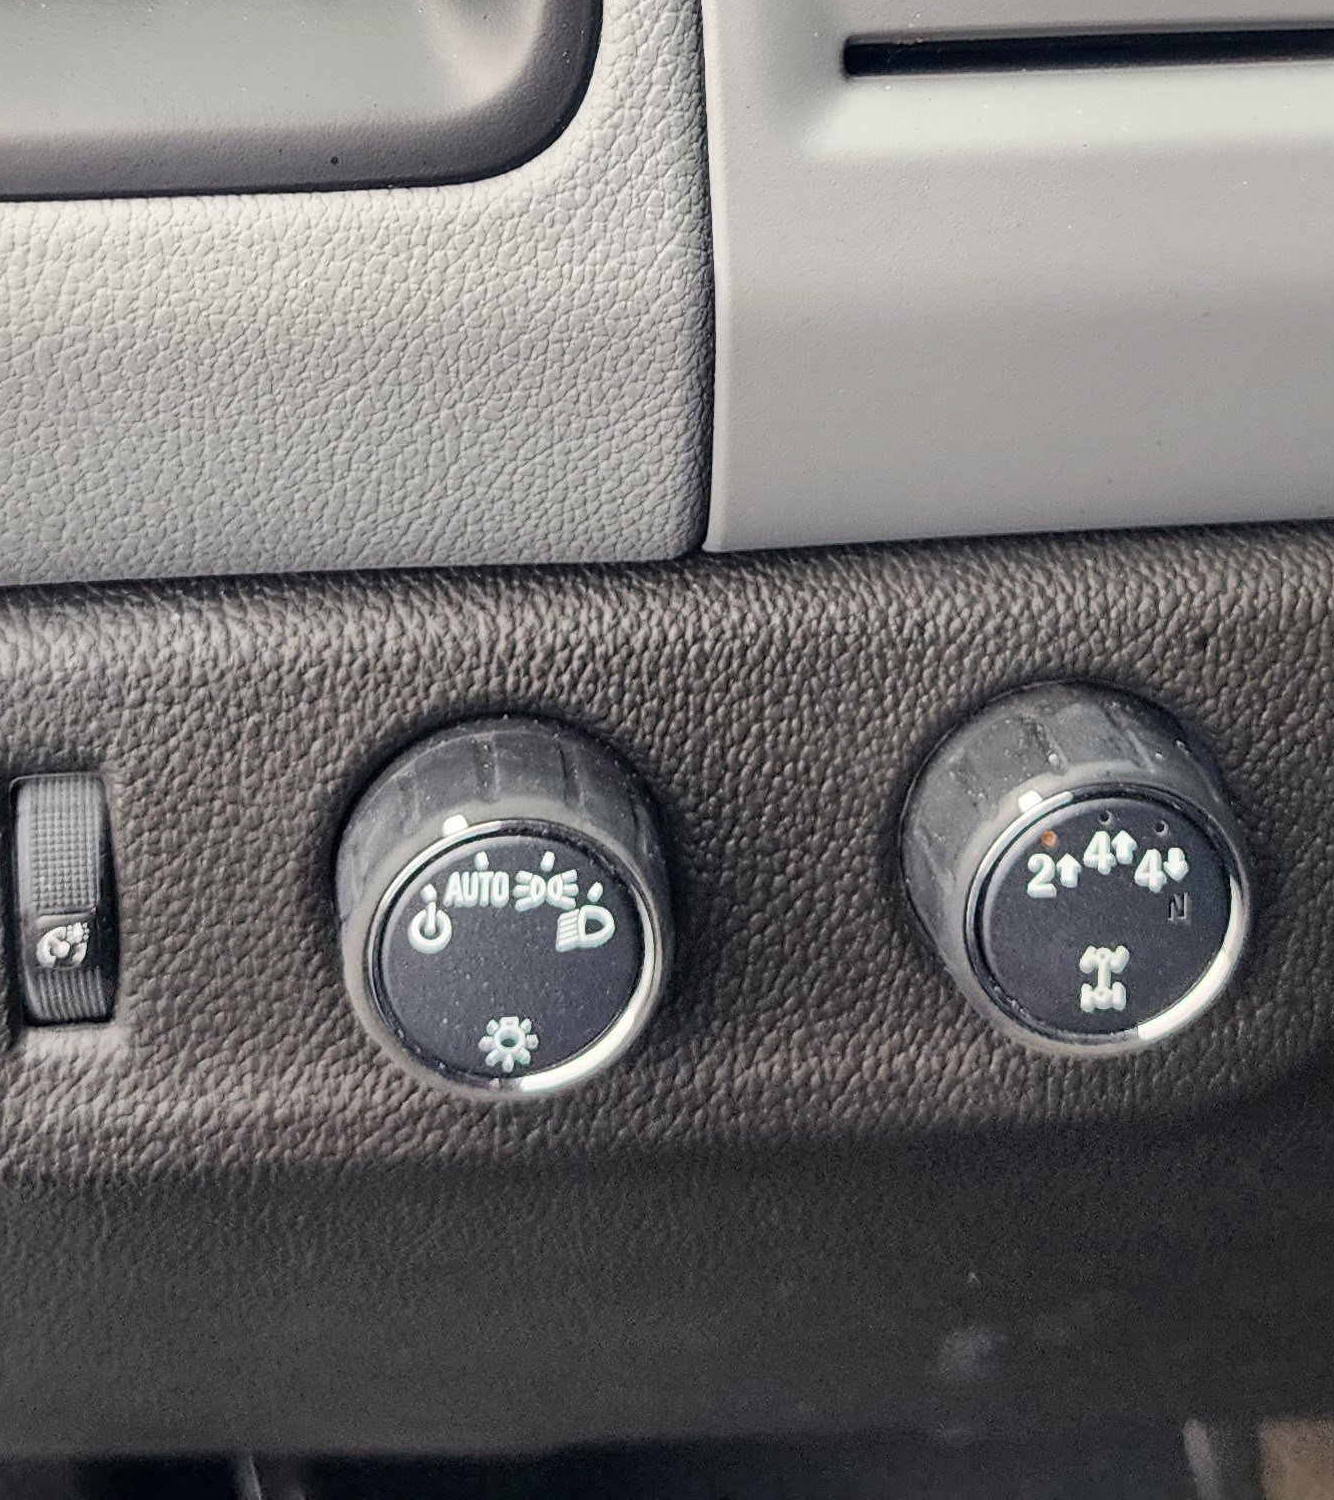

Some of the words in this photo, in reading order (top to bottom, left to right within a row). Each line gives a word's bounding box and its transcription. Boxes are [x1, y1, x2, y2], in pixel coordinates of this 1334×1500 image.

[1083, 830, 1116, 875] 4
[1134, 849, 1167, 894] 4
[443, 870, 510, 908] AUTO
[1026, 853, 1058, 898] 2
[1167, 891, 1191, 925] N
